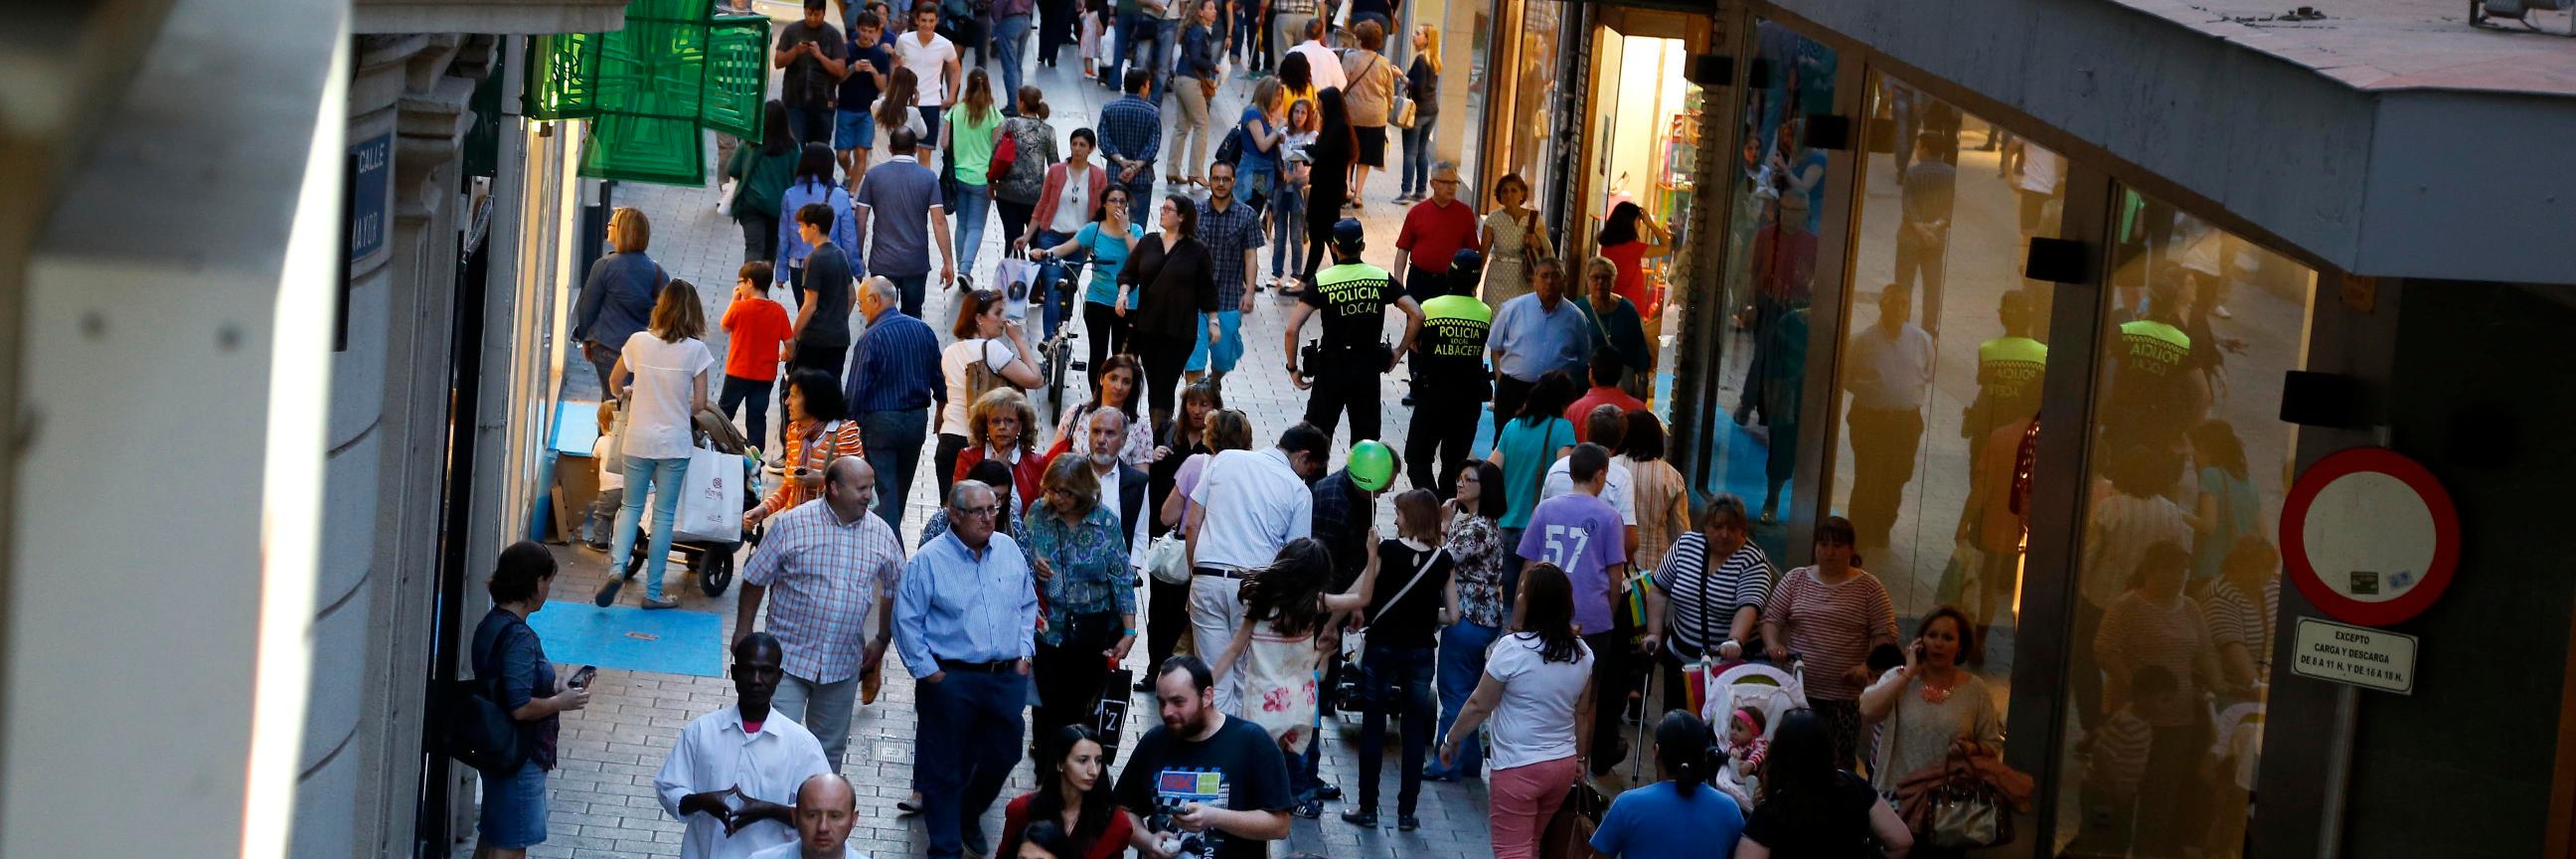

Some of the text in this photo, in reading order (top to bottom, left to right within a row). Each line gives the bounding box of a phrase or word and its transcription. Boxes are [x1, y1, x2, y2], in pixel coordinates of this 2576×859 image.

[359, 142, 385, 174] CALLE
[1329, 286, 1380, 304] POLICIA
[1340, 302, 1378, 316] LOCAL
[1439, 325, 1480, 339] POLICIA
[1434, 343, 1482, 357] ALBACETE
[1542, 524, 1588, 574] 57
[2335, 630, 2370, 645] EXCEPTO
[2315, 642, 2340, 656] CARGA
[2348, 648, 2390, 665] DESCARGA
[2301, 654, 2311, 665] DE
[2319, 657, 2325, 667] A
[2327, 659, 2334, 669] 11
[2347, 663, 2352, 672] Y
[2353, 664, 2364, 675] DE
[2377, 668, 2382, 678] A
